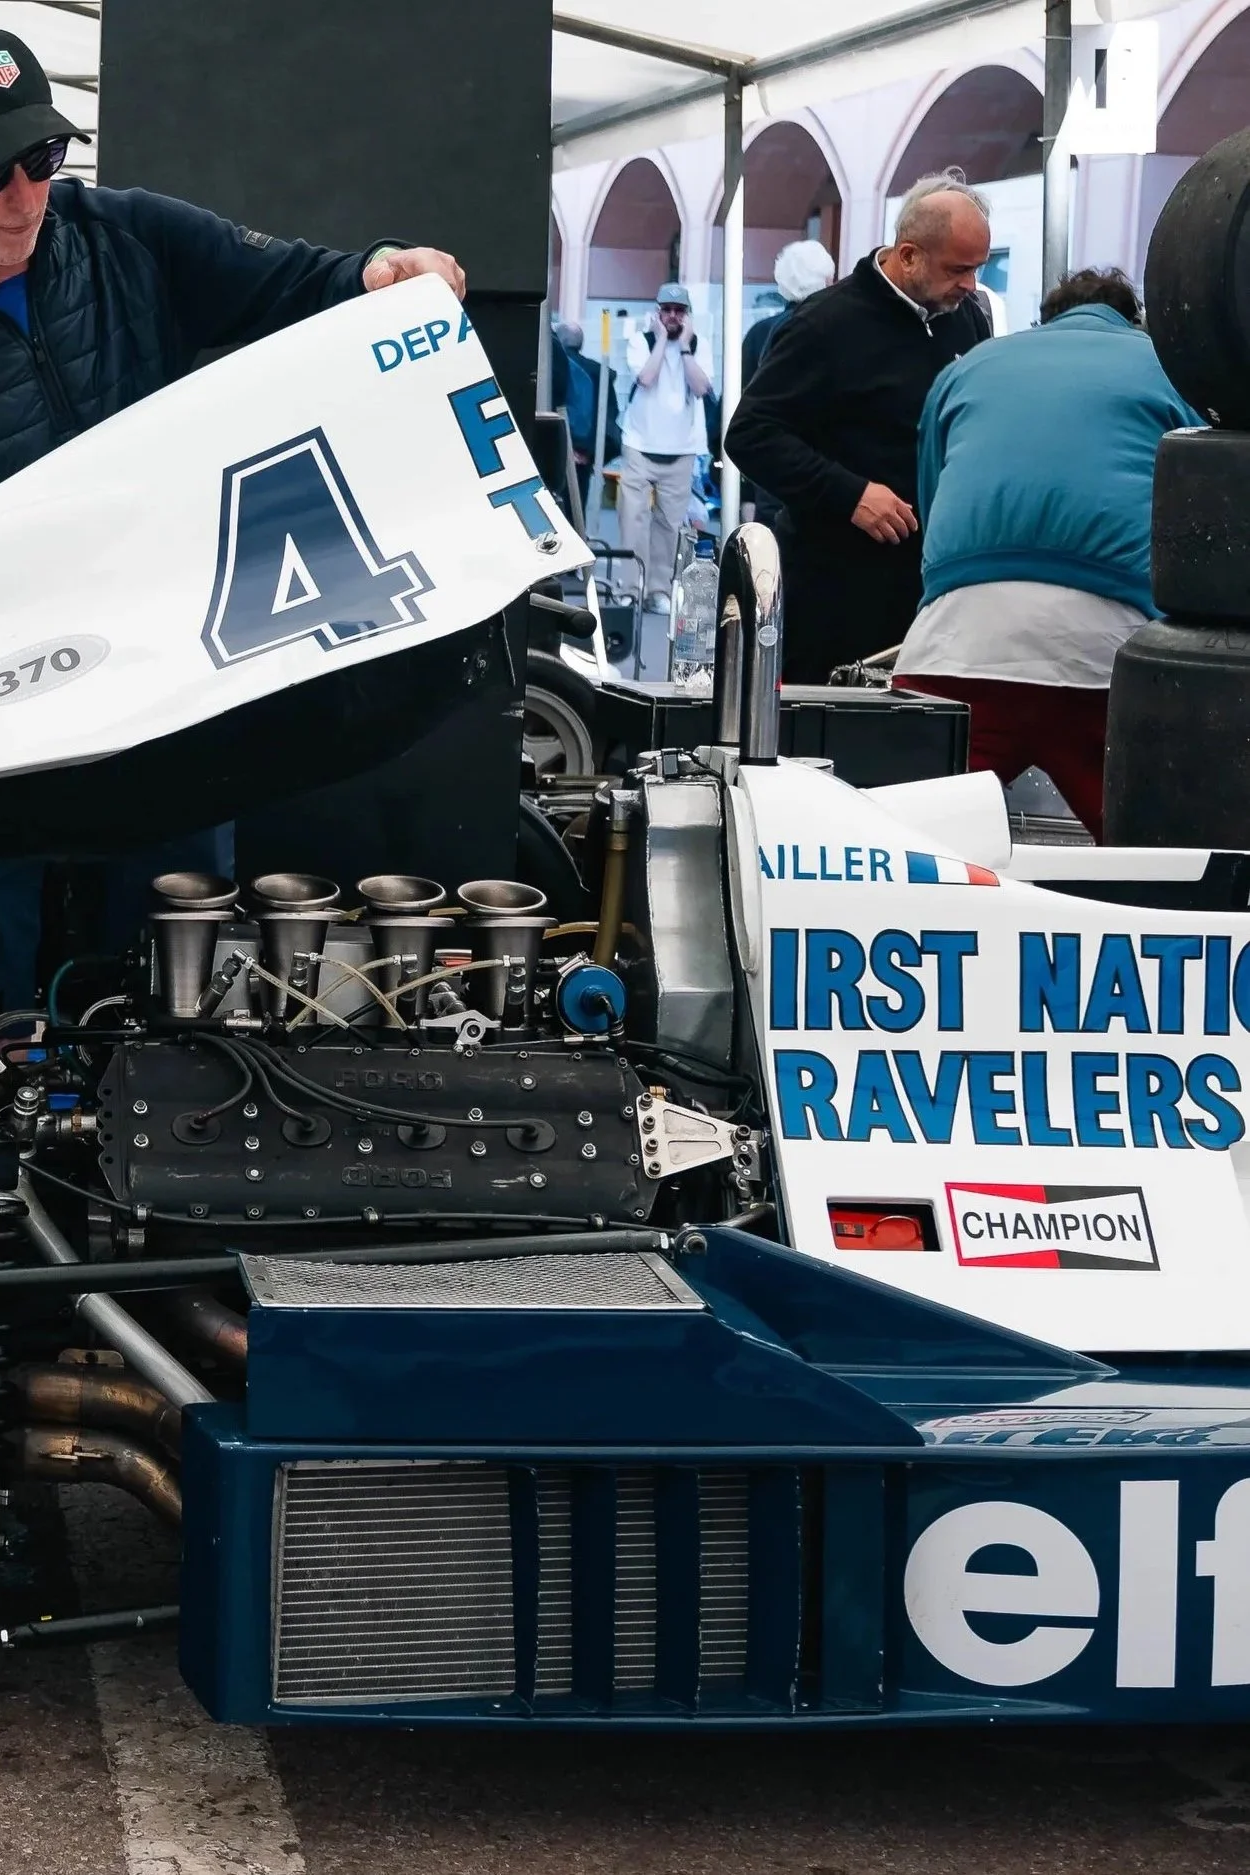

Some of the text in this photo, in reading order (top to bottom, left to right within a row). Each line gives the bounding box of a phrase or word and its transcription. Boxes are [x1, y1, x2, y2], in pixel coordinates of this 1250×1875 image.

[446, 375, 517, 479] F
[200, 425, 436, 670] 4
[486, 474, 558, 541] T
[769, 928, 1250, 1035] IRST NATI
[772, 1048, 1246, 1151] RAVELERS
[962, 1211, 1143, 1242] CHAMPION
